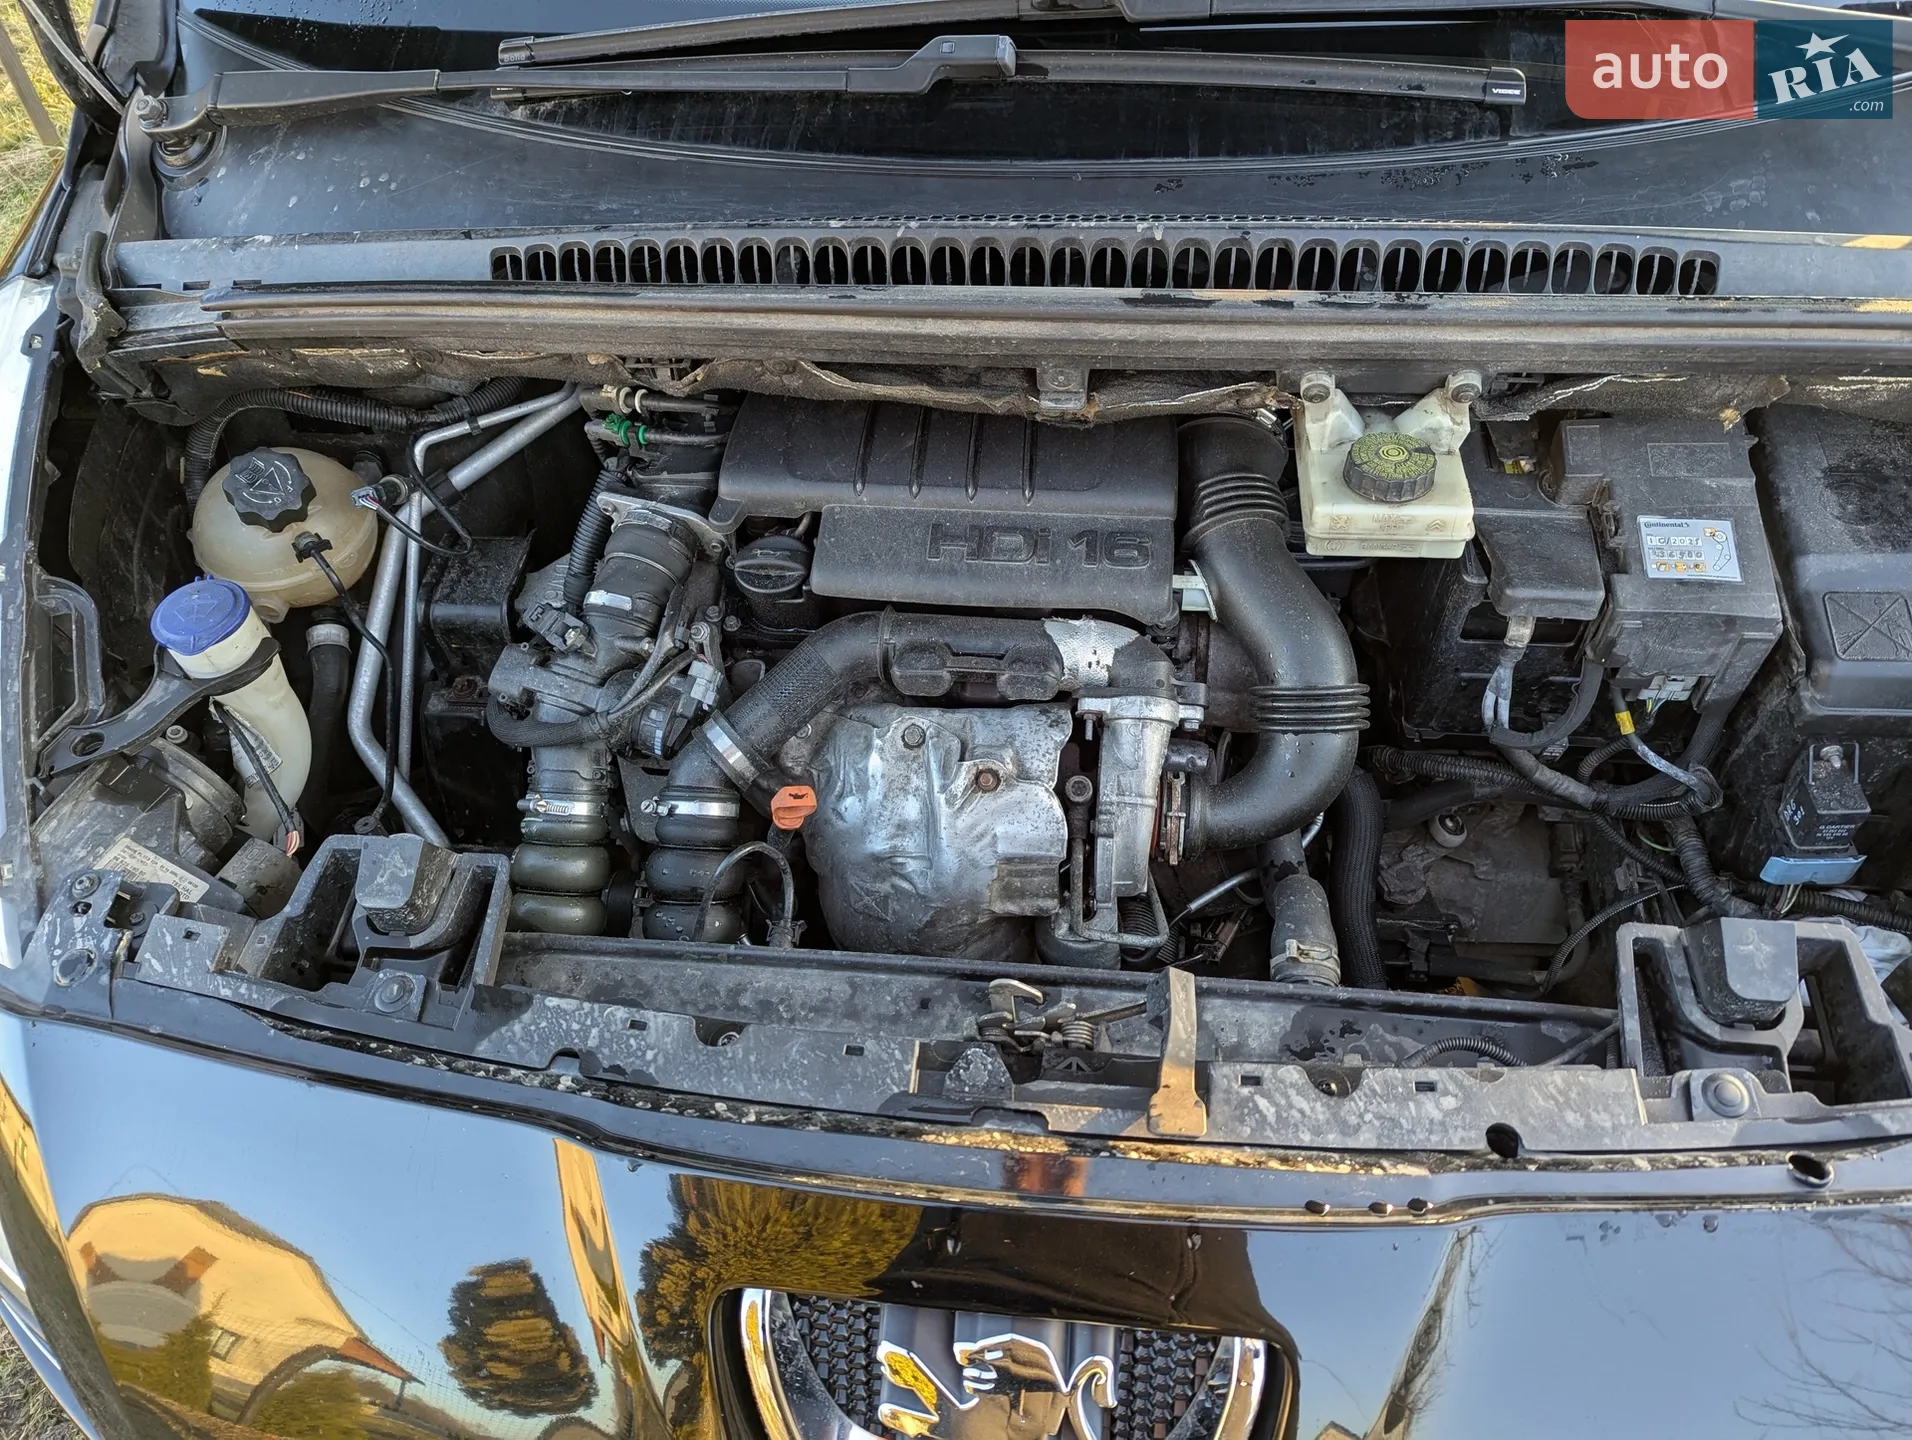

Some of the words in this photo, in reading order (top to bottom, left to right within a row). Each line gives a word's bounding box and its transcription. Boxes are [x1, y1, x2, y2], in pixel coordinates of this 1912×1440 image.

[1643, 521, 1684, 529] Continental
[926, 522, 1051, 564] HDi
[1066, 529, 1153, 570] 16
